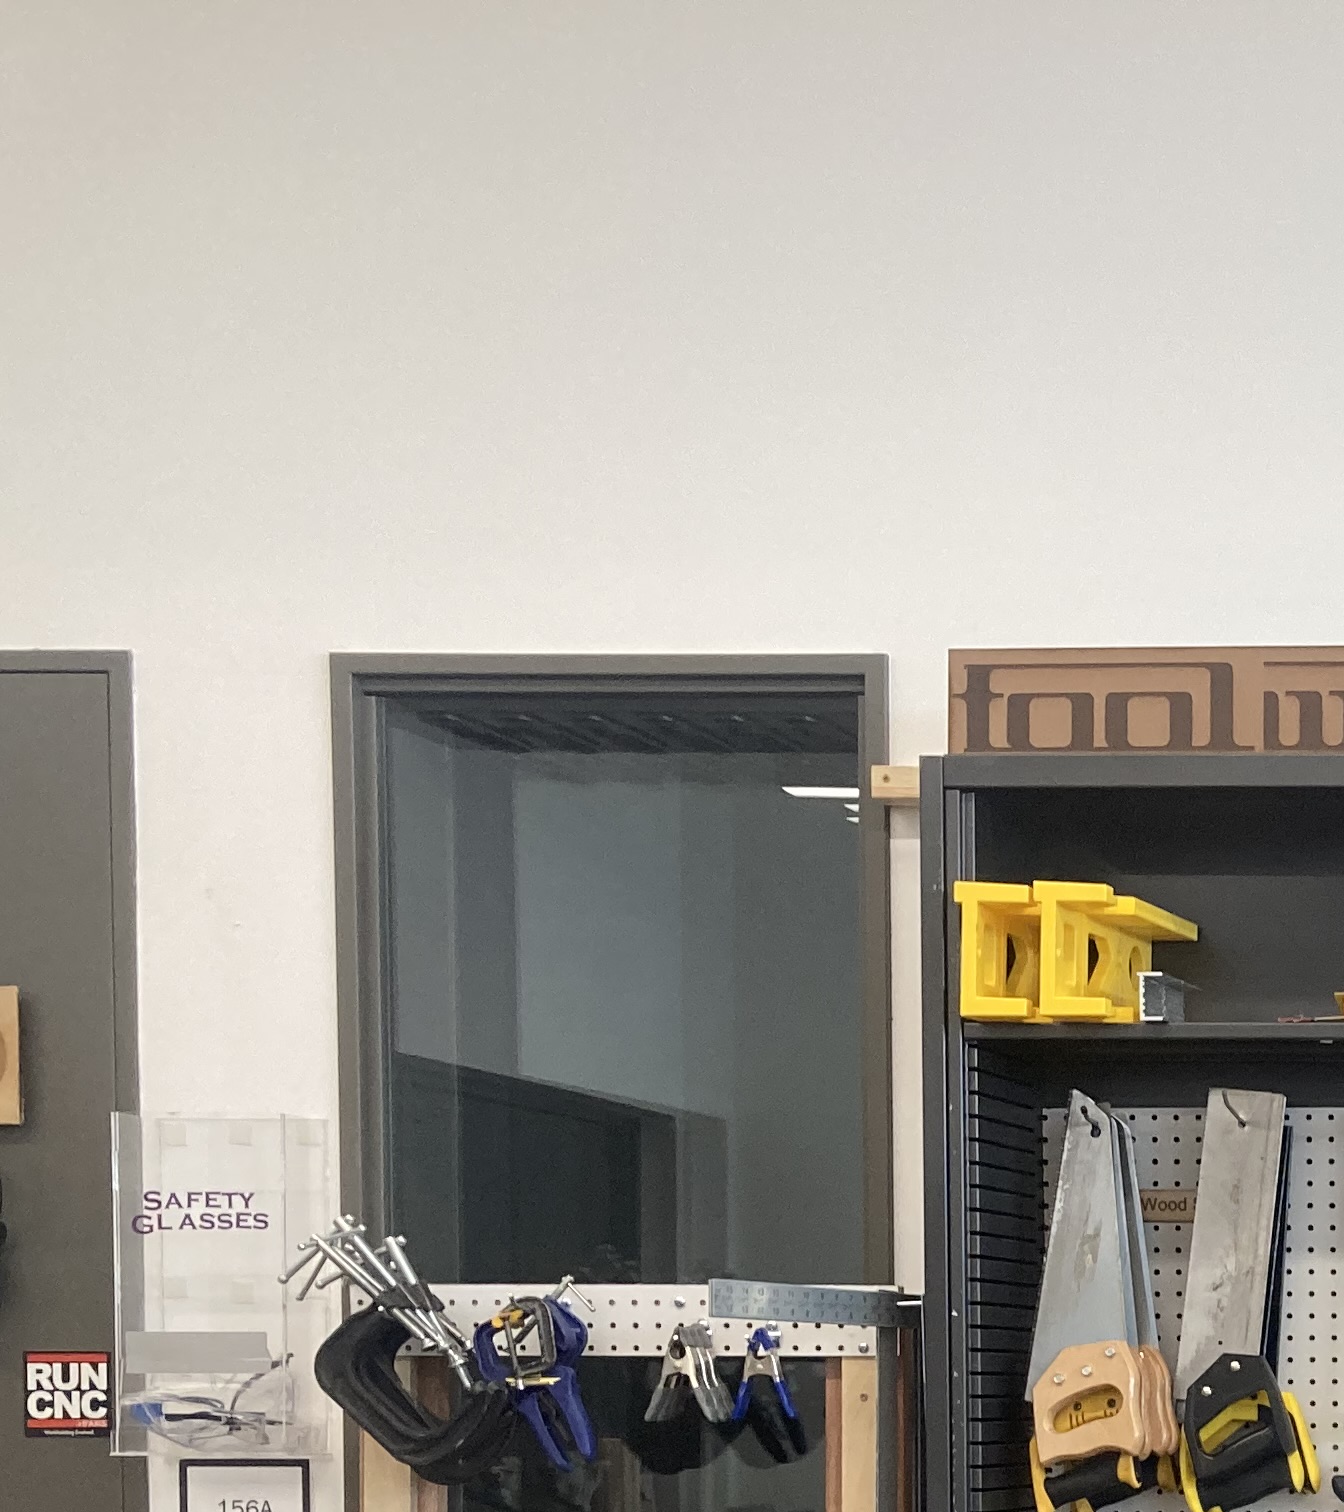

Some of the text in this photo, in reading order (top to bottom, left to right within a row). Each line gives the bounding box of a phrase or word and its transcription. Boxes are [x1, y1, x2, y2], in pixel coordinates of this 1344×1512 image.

[143, 1191, 255, 1211] SAFETY
[1142, 1198, 1187, 1212] Wood
[132, 1212, 269, 1234] GLASSES
[27, 1362, 107, 1391] RUN
[27, 1390, 107, 1419] CNC
